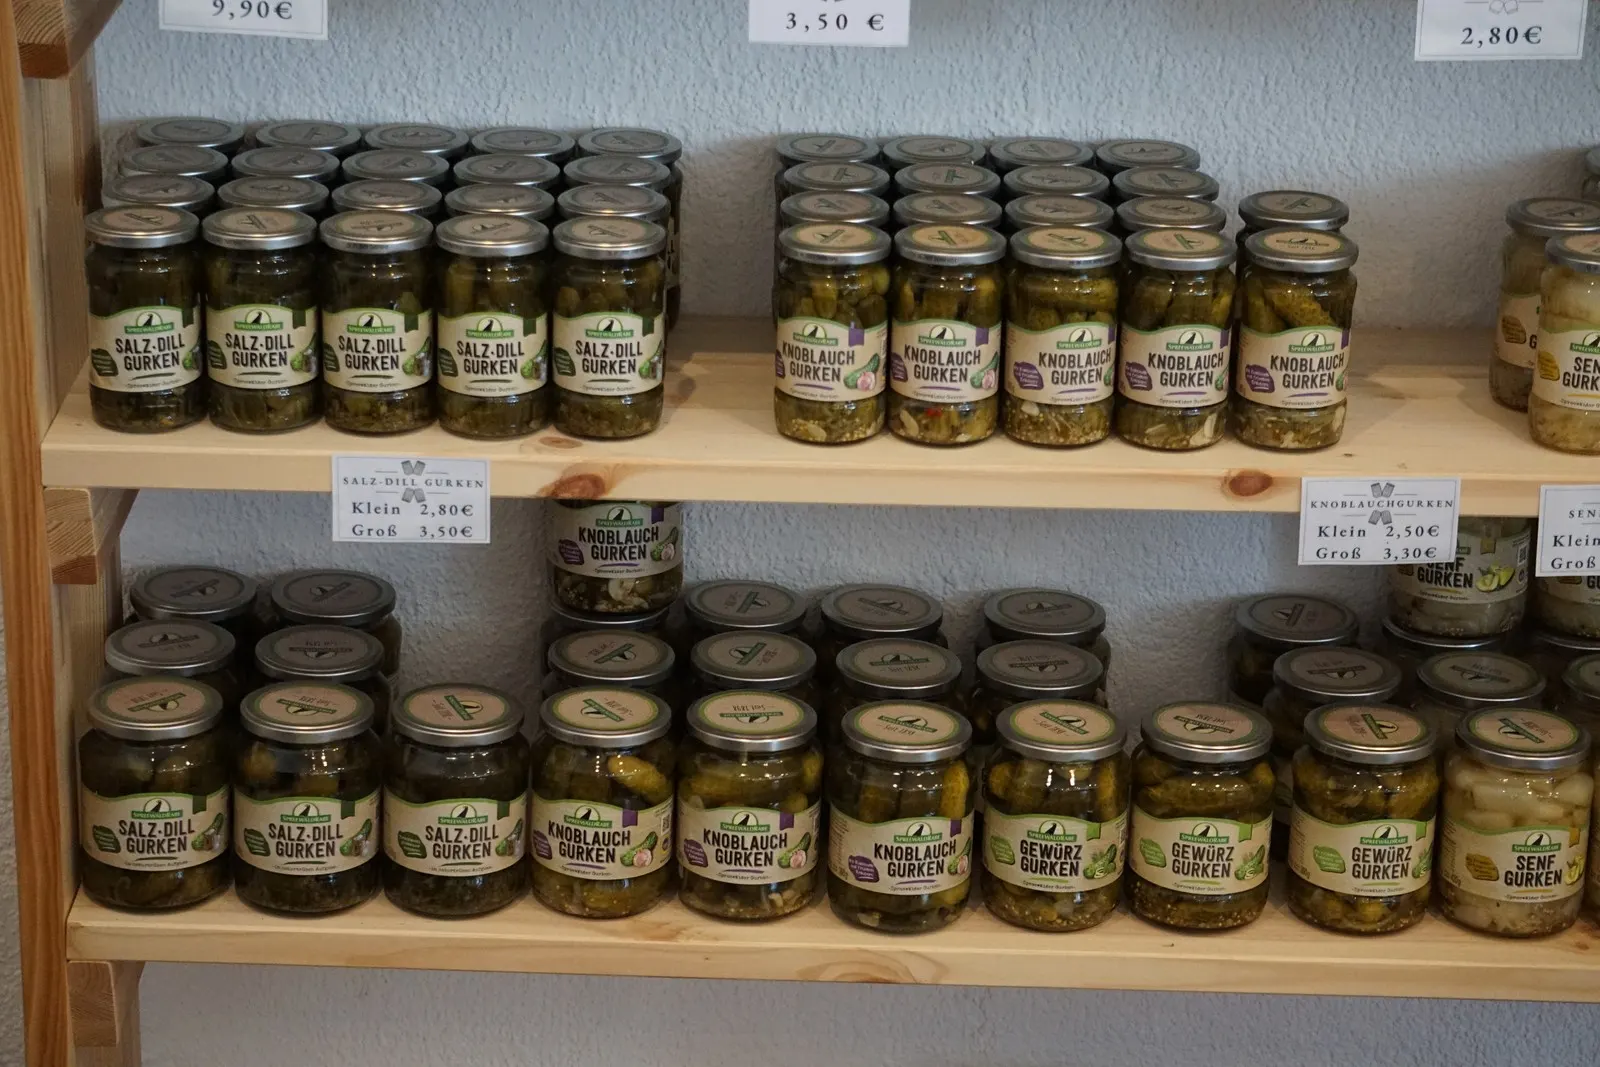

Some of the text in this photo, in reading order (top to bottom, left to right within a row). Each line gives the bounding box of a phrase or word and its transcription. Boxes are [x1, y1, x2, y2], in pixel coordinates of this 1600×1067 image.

[212, 0, 293, 20] 9,90€
[1461, 26, 1543, 48] 2,80€
[124, 351, 180, 371] GURKEN
[232, 351, 287, 368] GURKEN
[345, 354, 399, 371] GURKEN
[783, 344, 855, 366] KNOBLAUCH
[904, 345, 981, 366] KNOBLAUCH
[1039, 349, 1111, 370] KNOBLAUCH
[1148, 352, 1224, 371] KNOBLAUCH
[1270, 353, 1345, 372] KNOBLAUCH
[464, 359, 518, 376] GURKEN
[582, 358, 636, 375] GURKEN
[790, 360, 841, 382] GURKEN
[914, 365, 968, 383] GURKEN
[1574, 357, 1600, 374] SEN
[1051, 366, 1102, 385] GURKEN
[1160, 370, 1213, 387] GURKEN
[1282, 372, 1335, 388] GURKEN
[1562, 372, 1600, 391] GURK
[424, 478, 484, 489] GURKEN
[352, 501, 474, 517] Klein 2,80€
[1311, 499, 1453, 509] KNOBLAUCHGURKEN
[1569, 510, 1600, 518] SEN
[352, 523, 473, 540] Groß 3,50€
[579, 526, 659, 545] KNOBLAUCH
[1317, 525, 1440, 540] Klein 2,50€
[1552, 534, 1600, 548] Klein
[591, 544, 646, 561] GURKEN
[1316, 547, 1437, 561] Groß 3,30€
[1551, 556, 1596, 570] Groß
[1417, 566, 1474, 588] GURKEN
[548, 820, 631, 847] KNOBLAUCH
[703, 828, 787, 851] KNOBLAUCH
[126, 836, 187, 854] GURKEN
[276, 841, 335, 858] GURKEN
[433, 842, 491, 859] GURKEN
[560, 842, 616, 863] GURKEN
[874, 840, 956, 861] KNOBLAUCH
[1020, 840, 1082, 861] GEWÜRZ
[1172, 843, 1234, 862] GEWÜRZ
[715, 849, 773, 867] GURKEN
[1352, 846, 1412, 863] GEWÜRZ
[1516, 855, 1556, 870] SENF
[888, 860, 944, 878] GURKEN
[1020, 857, 1080, 877] GURKEN
[1172, 860, 1231, 879] GURKEN
[1351, 863, 1409, 879] GURKEN
[1504, 869, 1562, 887] GURKEN
